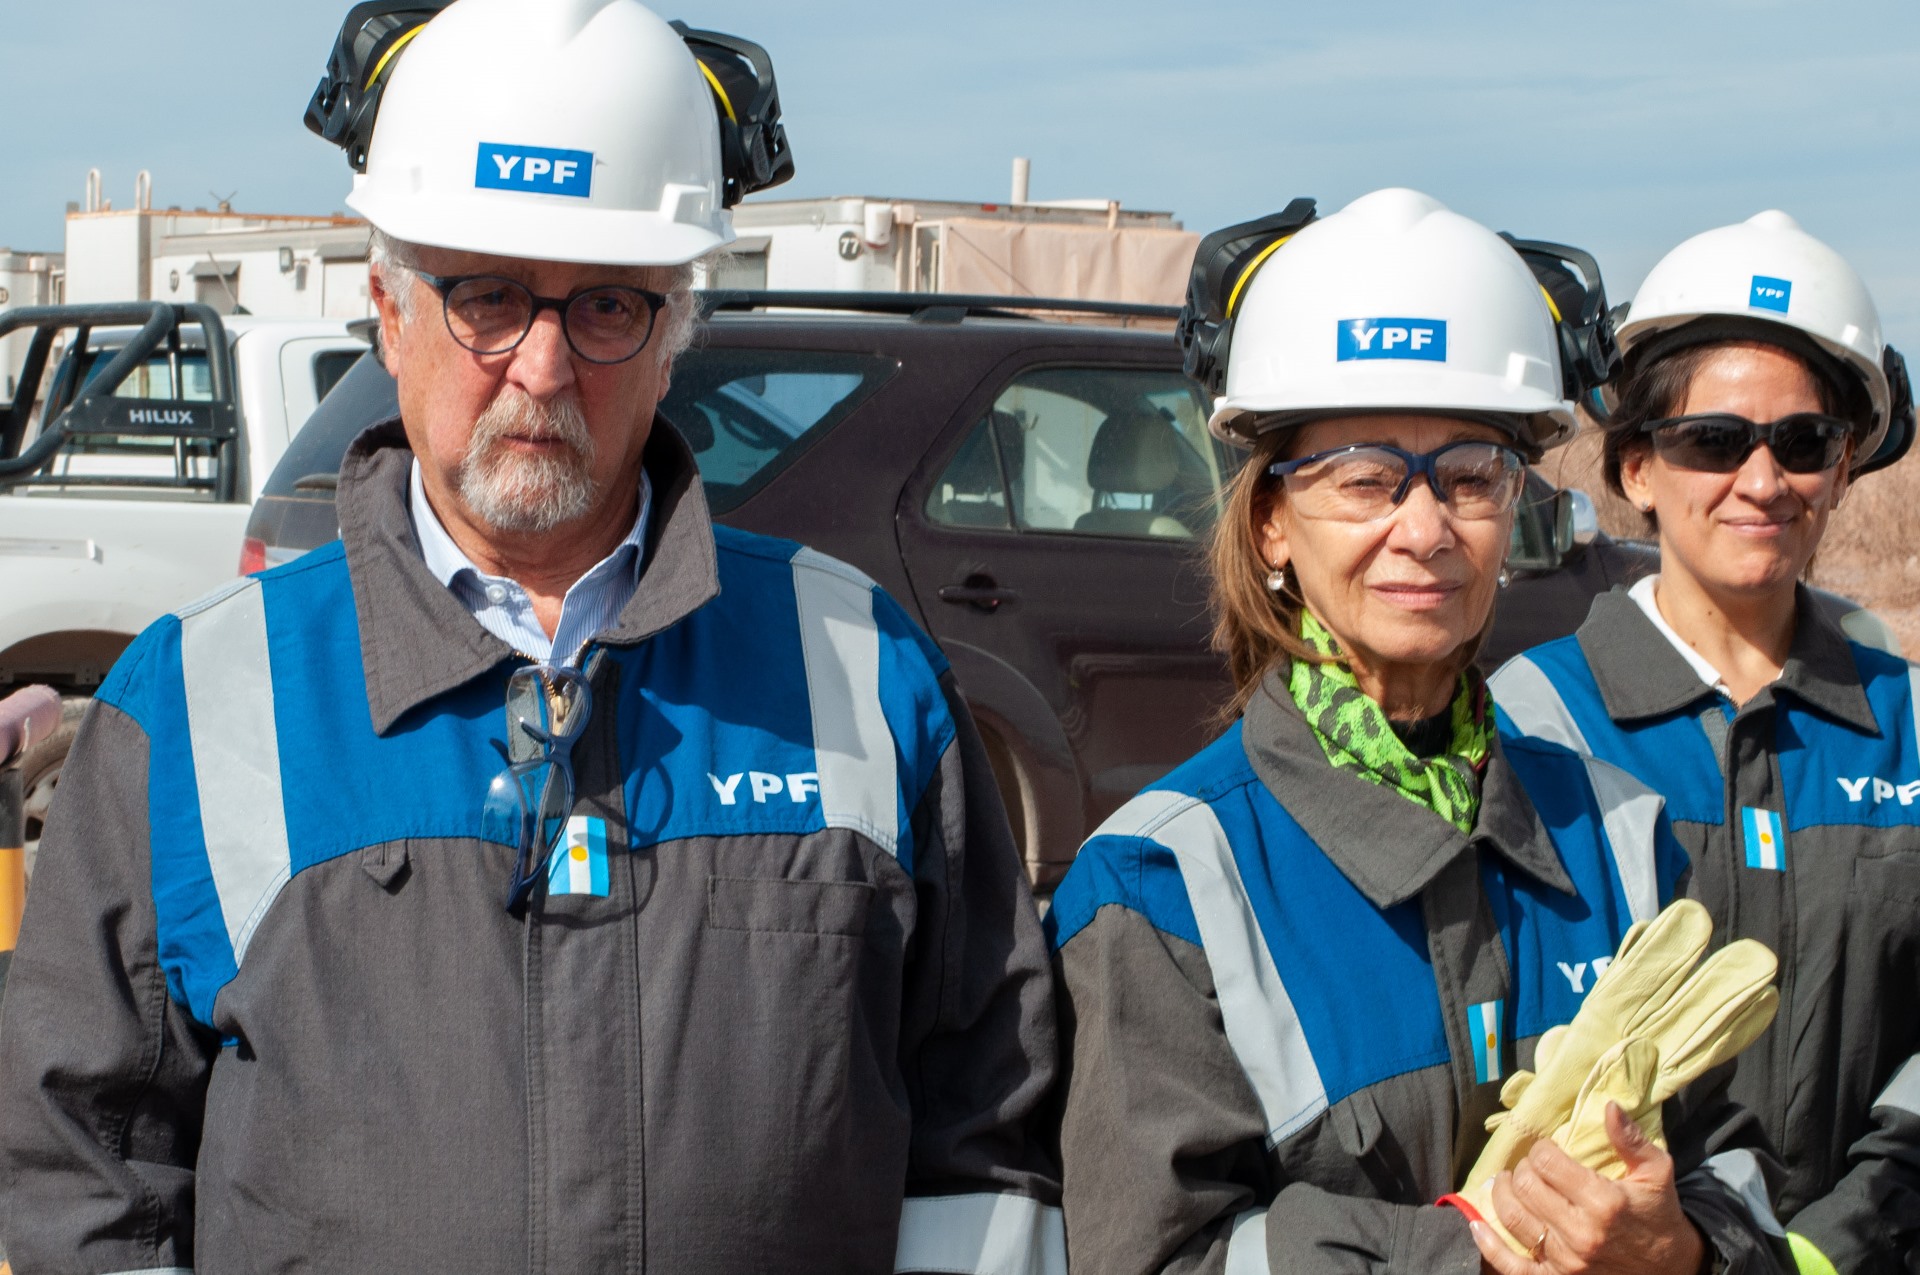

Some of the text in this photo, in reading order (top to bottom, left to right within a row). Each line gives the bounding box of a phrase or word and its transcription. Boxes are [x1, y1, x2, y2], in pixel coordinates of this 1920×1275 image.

[492, 153, 578, 184] YPF
[841, 237, 859, 254] 77
[1756, 286, 1785, 299] YPF
[1351, 327, 1433, 350] YPF
[129, 409, 193, 424] HILUX
[707, 771, 818, 805] YPF
[1836, 776, 1920, 806] YPF
